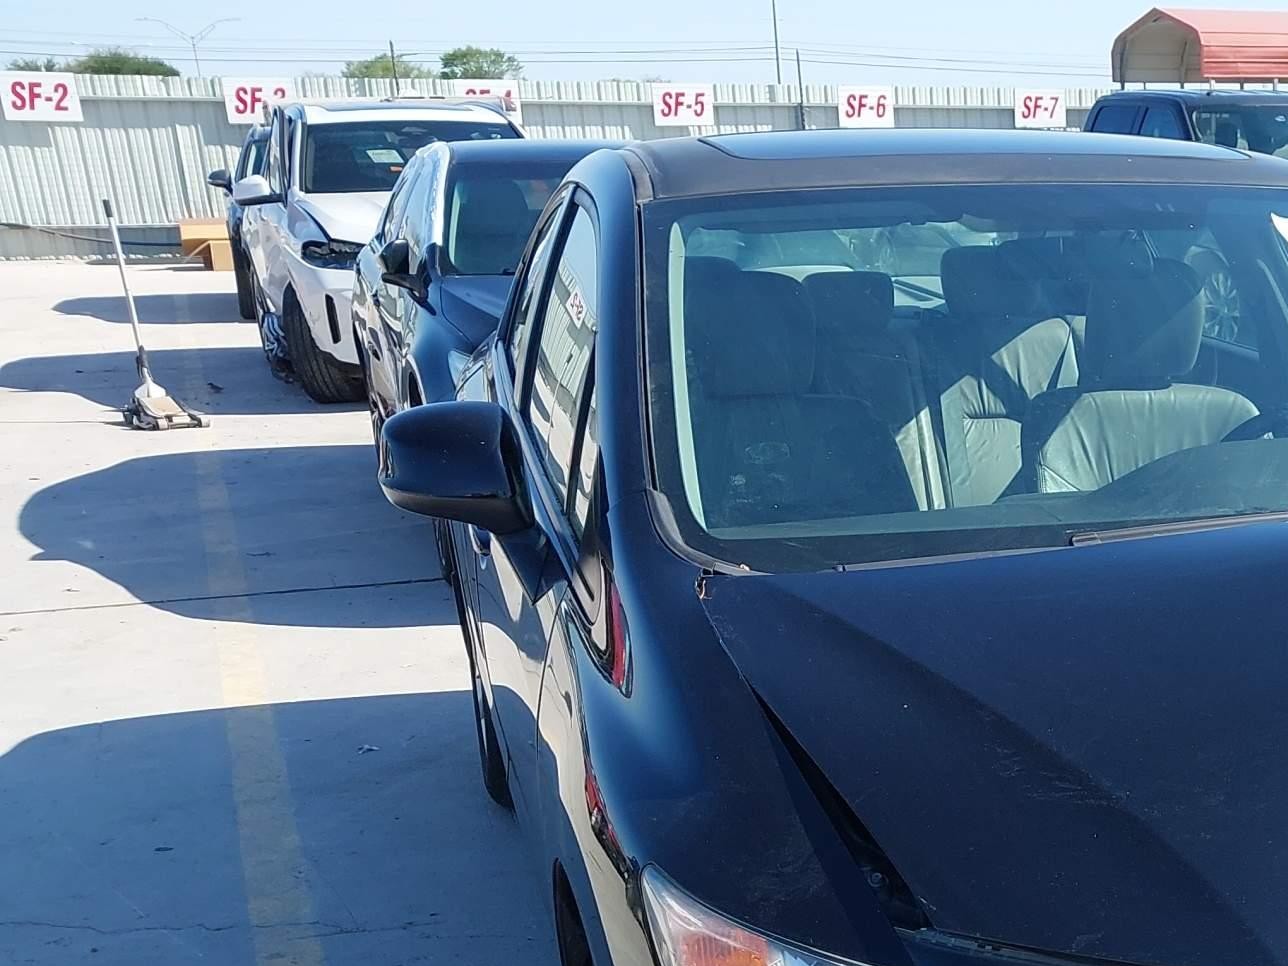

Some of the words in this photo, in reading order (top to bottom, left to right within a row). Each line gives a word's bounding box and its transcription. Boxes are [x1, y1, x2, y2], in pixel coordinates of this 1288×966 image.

[11, 81, 69, 111] SF-2
[661, 91, 705, 117] SF-5
[846, 94, 887, 118] SF-6
[1022, 95, 1059, 119] SF-7
